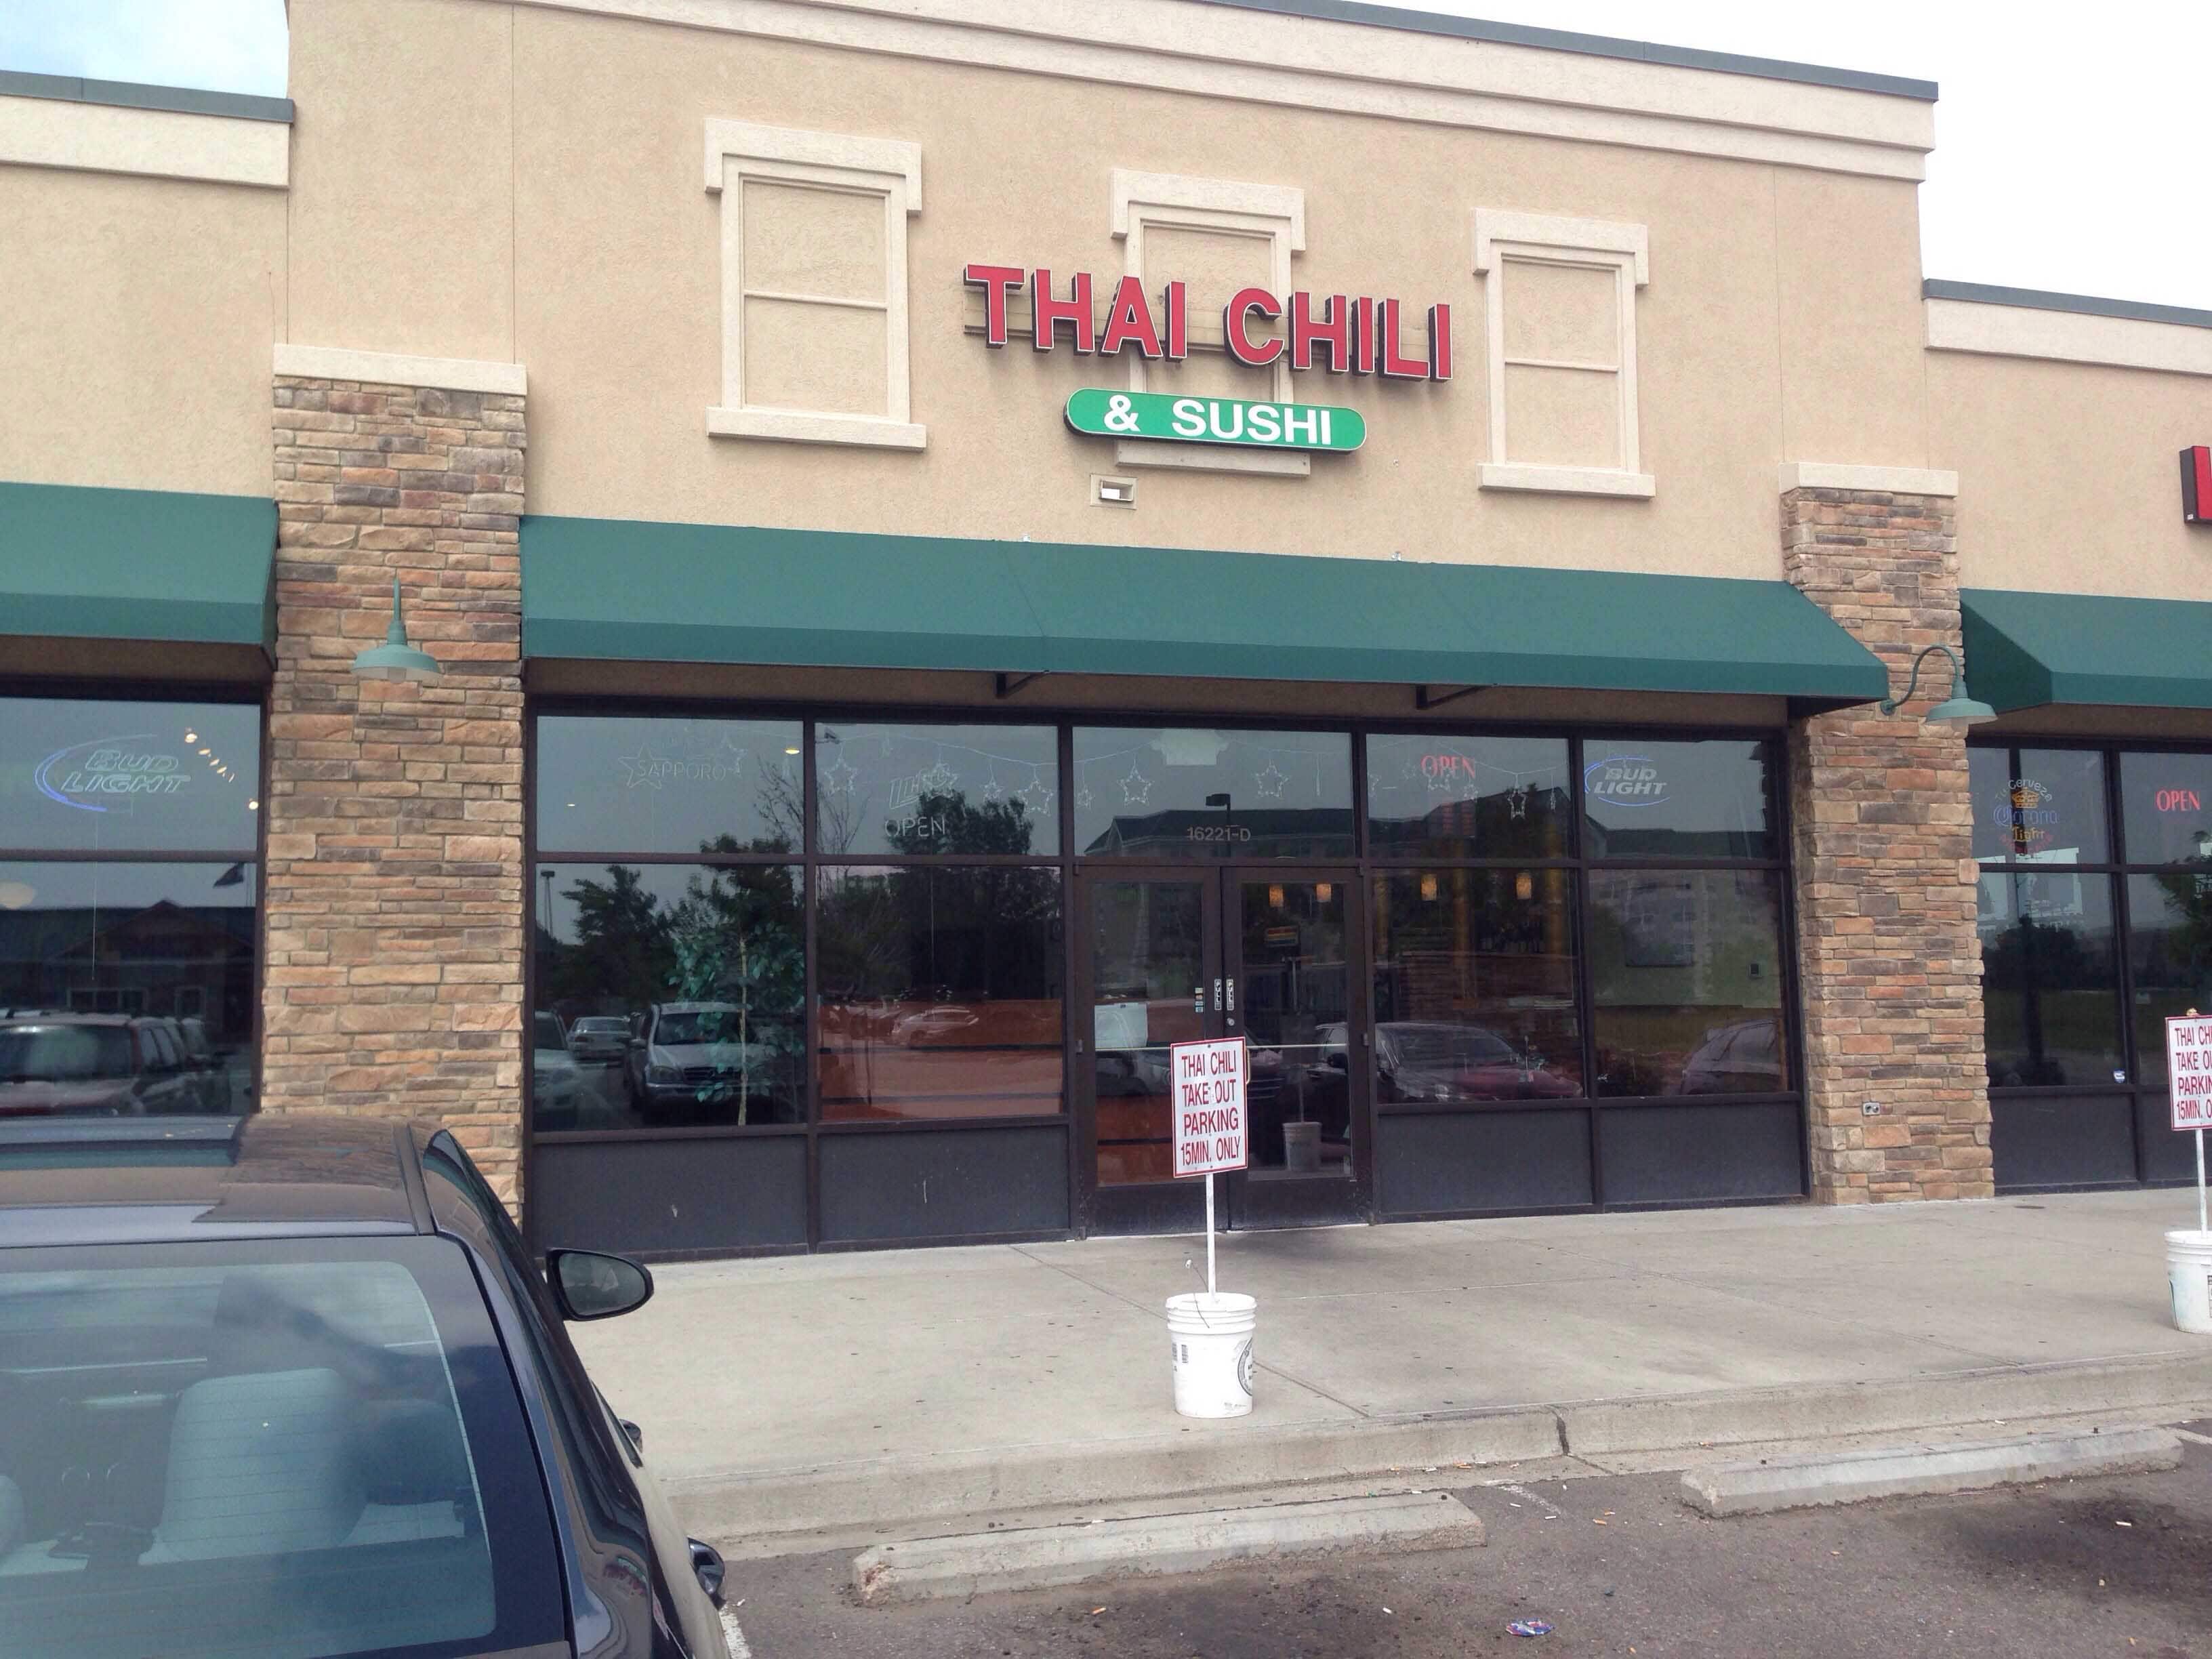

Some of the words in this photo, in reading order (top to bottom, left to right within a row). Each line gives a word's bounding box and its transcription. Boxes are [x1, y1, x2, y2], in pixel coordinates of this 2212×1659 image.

[964, 264, 1187, 361] THAI
[1224, 287, 1453, 382] CHILI
[1103, 394, 1141, 432] &
[1172, 398, 1332, 445] SUSHI
[85, 749, 179, 772] BUD
[638, 759, 727, 781] SAPPORO
[1420, 754, 1475, 779] OPEN
[60, 771, 191, 793] LIGHT
[1604, 767, 1657, 781] BUD
[1594, 781, 1668, 795] LIGHT
[2156, 789, 2200, 812] OPEN
[884, 816, 945, 838] OPEN
[1187, 826, 1251, 842] 16221-D
[2175, 1027, 2195, 1046] THAI
[1181, 1054, 1205, 1078] THAI
[1210, 1050, 1236, 1076] CHILI
[2175, 1051, 2199, 1071] TAKE
[1182, 1082, 1209, 1107] TAKE
[1214, 1079, 1236, 1103] OUT
[1184, 1107, 1239, 1136] PARKING
[1181, 1140, 1212, 1166] 15MIN.
[1216, 1136, 1240, 1161] ONLY
